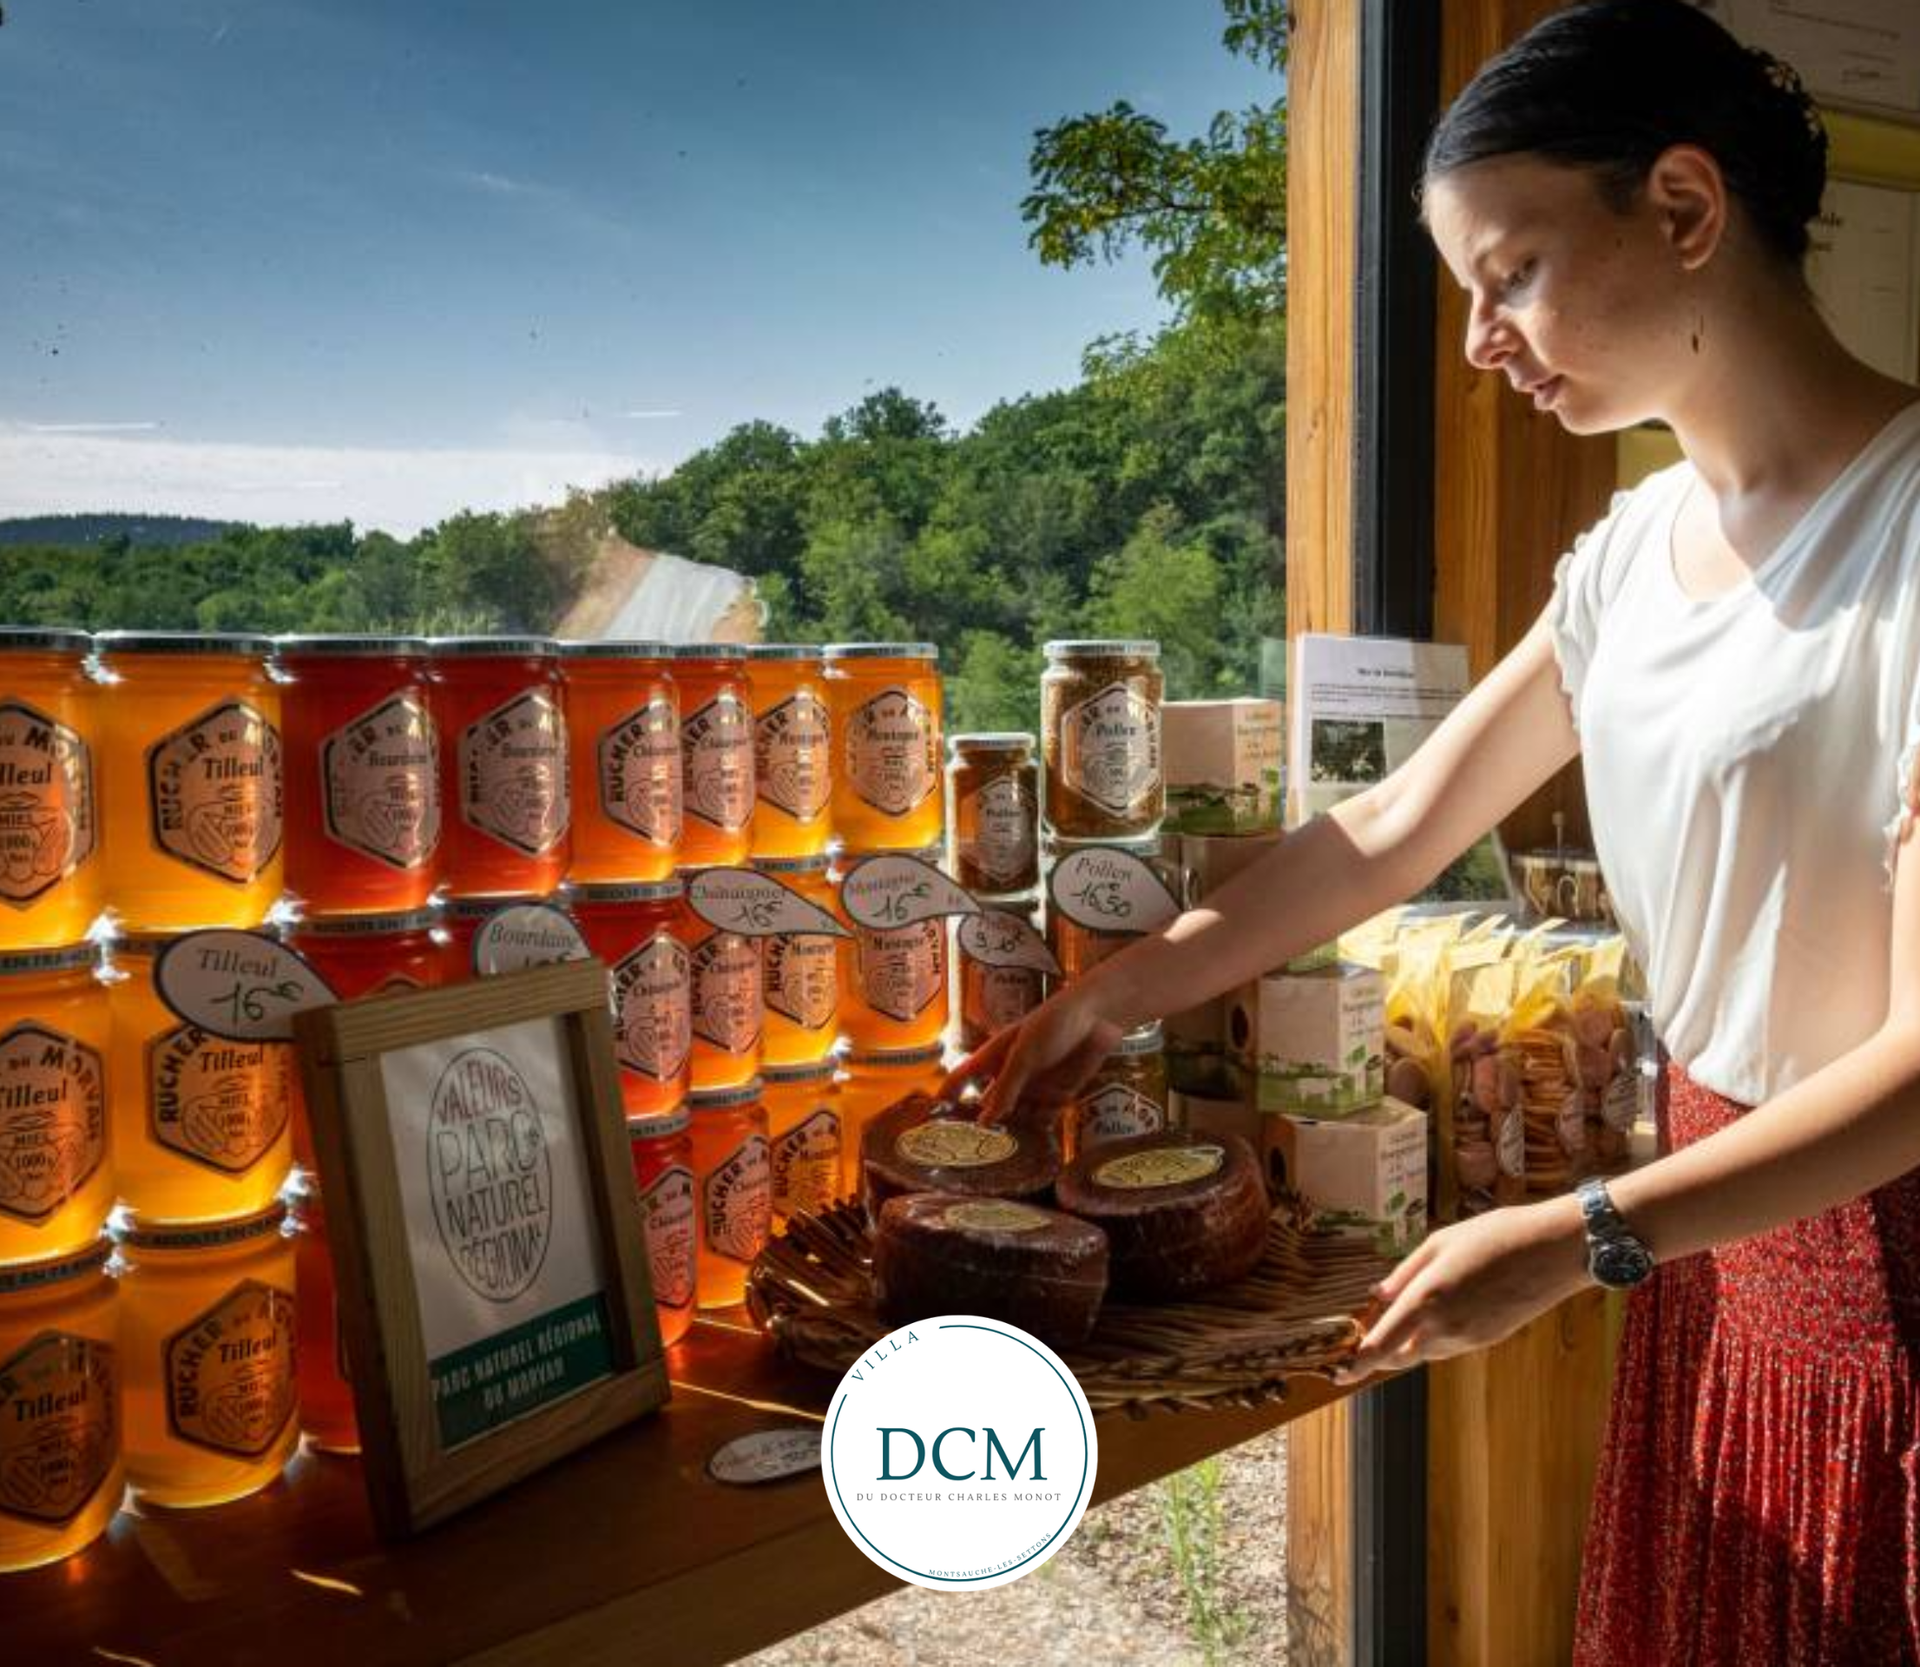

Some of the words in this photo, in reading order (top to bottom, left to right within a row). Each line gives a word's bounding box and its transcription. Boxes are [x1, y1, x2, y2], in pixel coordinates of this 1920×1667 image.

[1095, 722, 1137, 739] Pollen
[203, 756, 264, 780] Tilleul
[1077, 857, 1132, 880] Pollen
[201, 949, 278, 978] Tilleul
[158, 1026, 209, 1124] RUCHER
[199, 1042, 263, 1073] Tilleul
[0, 1077, 67, 1109] illeul
[774, 1130, 808, 1198] RUCHER
[446, 1173, 546, 1239] NATUREL
[711, 1161, 745, 1237] RUCHER
[176, 1317, 223, 1417] RUCHER
[217, 1327, 277, 1364] Tilleul
[431, 1365, 471, 1401] PARC
[474, 1337, 534, 1382] NATUREL
[507, 1355, 566, 1400] MORVAN
[13, 1379, 88, 1422] Tilleul
